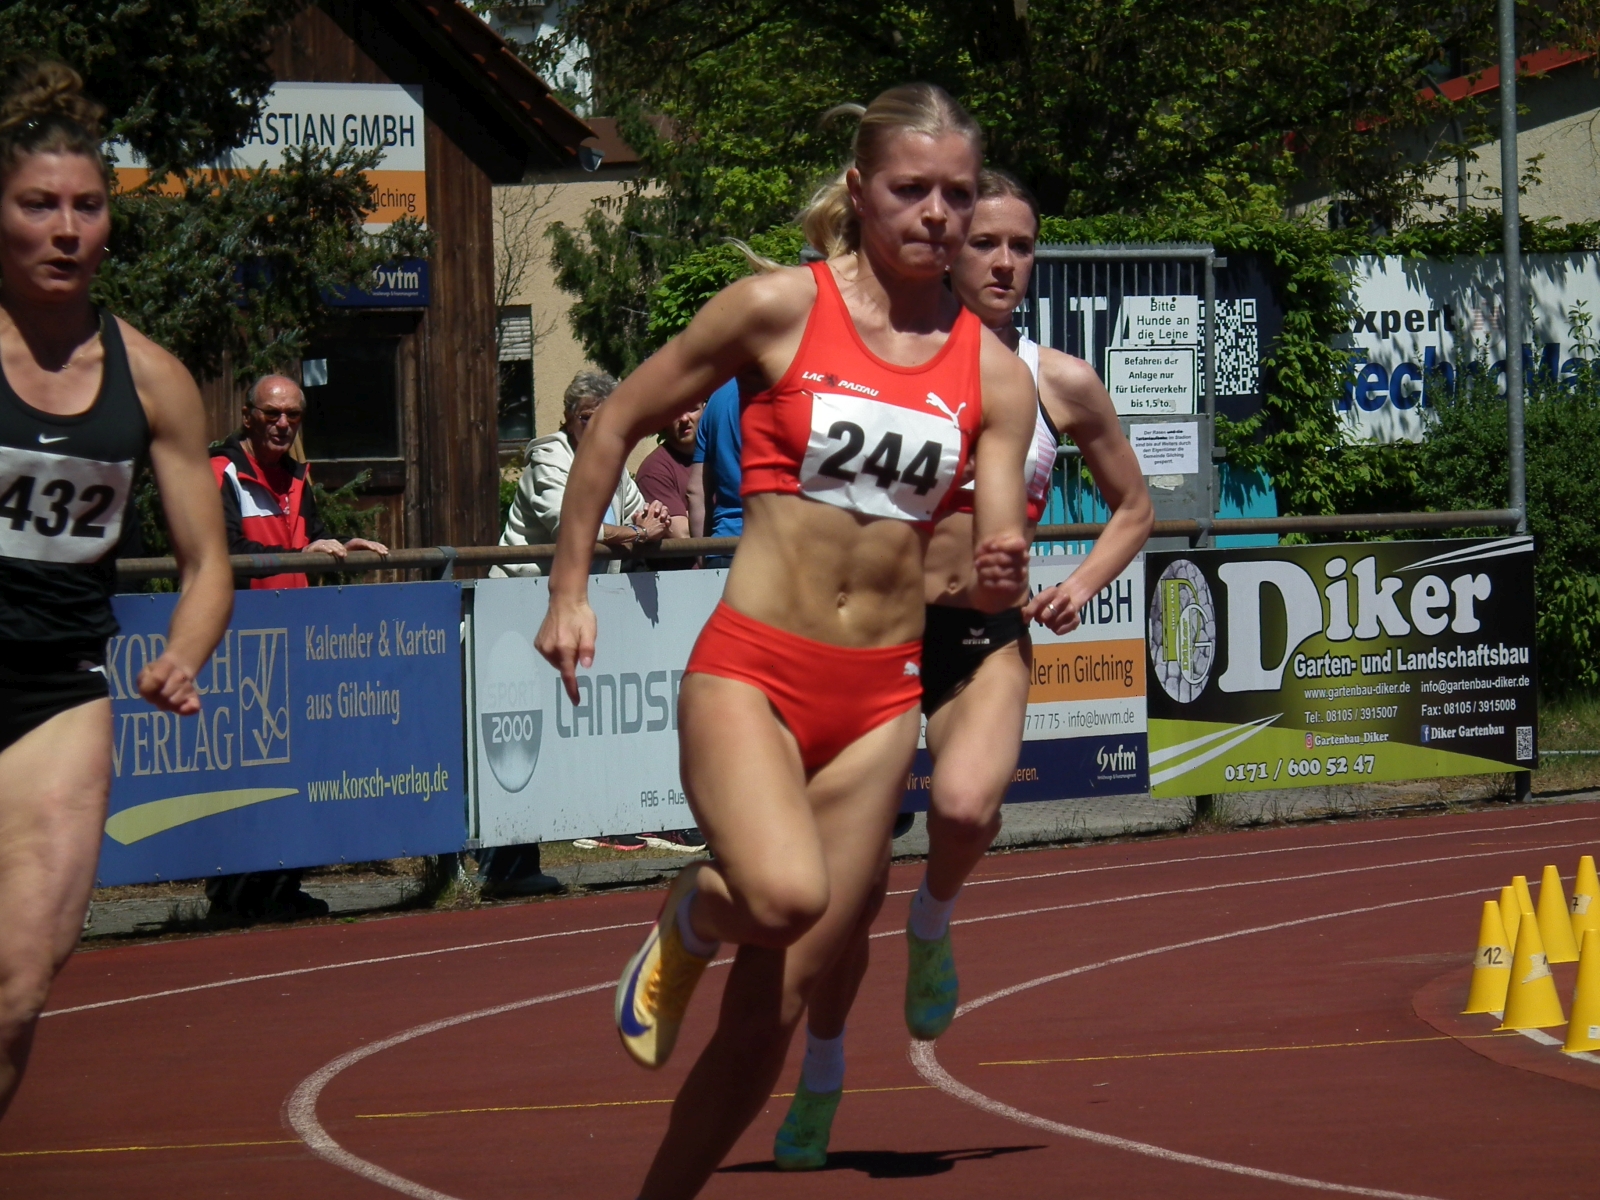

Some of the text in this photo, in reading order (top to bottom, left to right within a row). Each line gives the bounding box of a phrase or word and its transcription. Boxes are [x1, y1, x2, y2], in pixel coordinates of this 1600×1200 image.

[248, 112, 415, 147] ASTIAN GMBH
[1150, 301, 1176, 312] Bitte
[1137, 315, 1190, 326] Hunde an
[1340, 304, 1456, 340] xpert
[1138, 329, 1189, 340] die Leine
[1124, 356, 1179, 366] Befahren der
[801, 371, 880, 397] LAC PASSAU
[1115, 384, 1187, 394] für Lieferverkehr
[1128, 371, 1175, 381] Anlage nur
[1130, 399, 1171, 409] bis 1,5 to.
[817, 420, 943, 496] 244
[0, 475, 115, 538] 432
[1217, 555, 1492, 693] Diker
[305, 619, 446, 661] Kalender & Karten
[1030, 654, 1134, 688] ler in Gilching
[1294, 642, 1530, 678] Garten- und Landschaftsbau
[486, 680, 538, 709] SPORT
[1303, 681, 1411, 701] www.gartenbau-diker.de
[1420, 674, 1530, 695] info@gartenbau-diker.de
[306, 680, 400, 726] aus Gilching
[555, 670, 682, 739] LANDS
[1326, 708, 1353, 723] 08105
[1360, 705, 1398, 720] 3915007
[1421, 703, 1441, 717] Fax:
[1443, 701, 1472, 715] 08105
[1478, 698, 1517, 713] 3915008
[491, 714, 533, 744] 2000
[1034, 713, 1046, 730] 77
[1049, 712, 1060, 730] 75
[1068, 708, 1135, 729] info@bwvm.de
[1431, 726, 1457, 740] Diker
[1458, 723, 1505, 738] Gartenbau
[111, 705, 234, 779] VERLAG
[1314, 732, 1389, 747] Gartenbau_Diker
[1109, 744, 1136, 771] vfm
[1224, 754, 1375, 782] 0171 / 600 52 47
[307, 762, 449, 803] www.korsch-verlag.de
[640, 790, 659, 808] A96
[1483, 946, 1504, 965] 12
